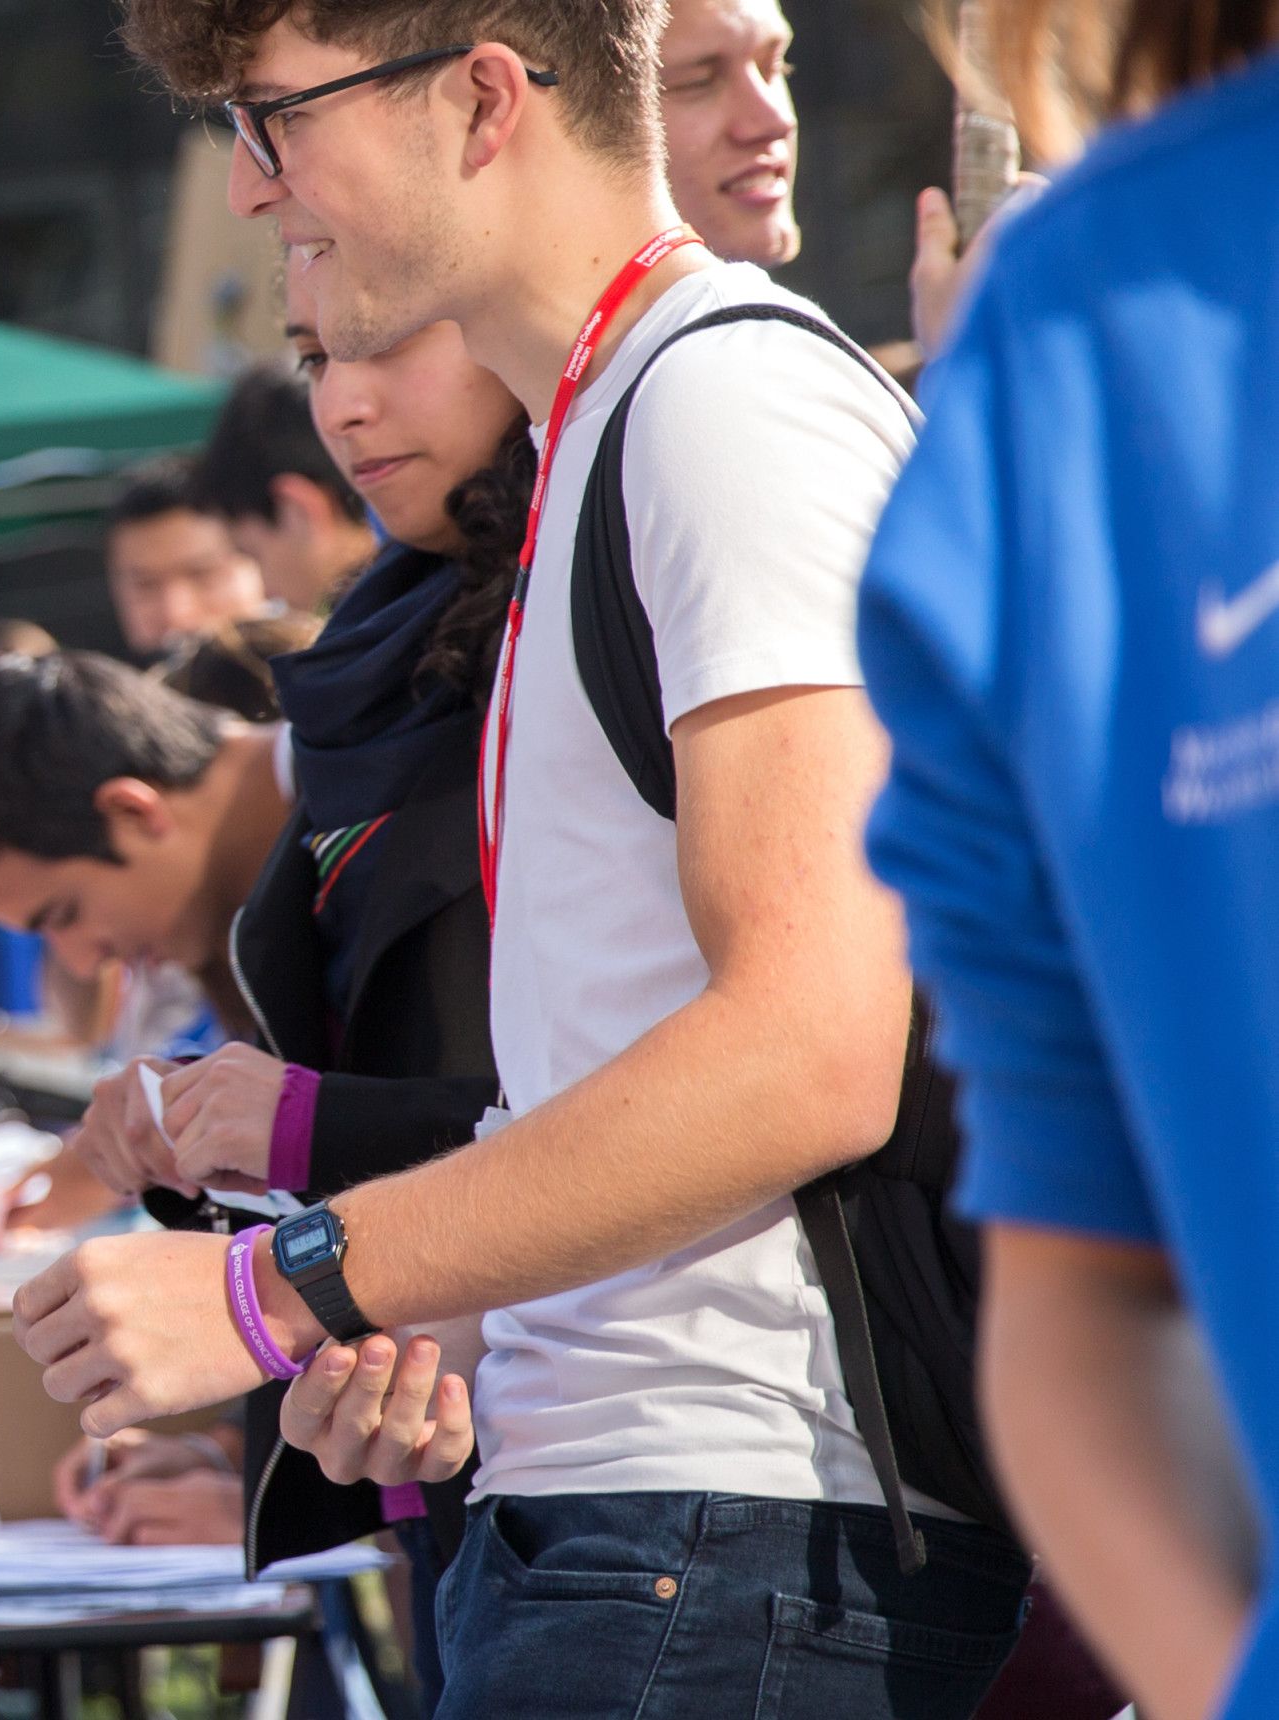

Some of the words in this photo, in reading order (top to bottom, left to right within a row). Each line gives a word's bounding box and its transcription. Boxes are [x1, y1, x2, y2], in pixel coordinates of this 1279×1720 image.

[634, 239, 662, 263] Imperial
[643, 244, 672, 267] London
[564, 342, 585, 378] Imperial
[579, 311, 602, 342] College
[570, 346, 592, 381] London
[235, 1279, 250, 1316] COLLEGE
[244, 1316, 254, 1328] OF
[249, 1328, 273, 1360] SCIENCE
